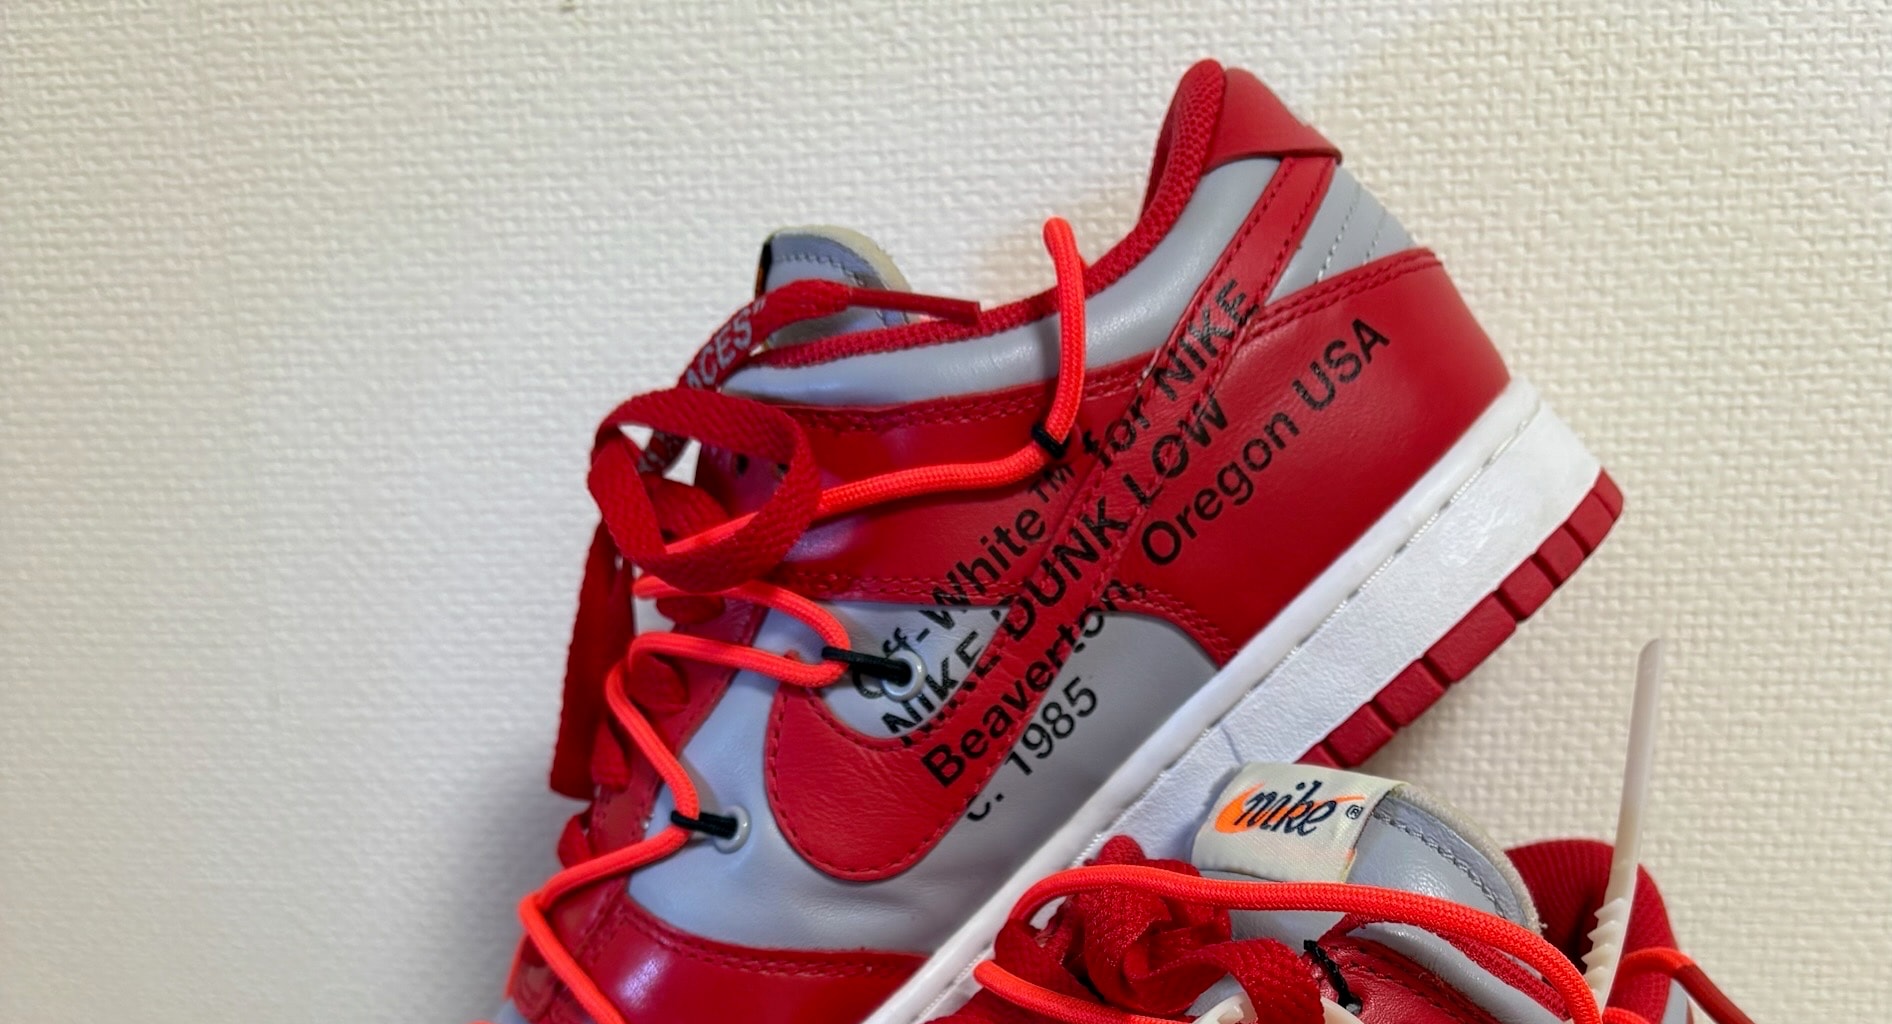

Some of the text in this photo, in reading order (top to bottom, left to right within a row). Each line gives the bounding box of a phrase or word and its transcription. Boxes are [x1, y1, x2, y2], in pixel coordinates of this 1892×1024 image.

[1082, 395, 1151, 469] for
[1153, 279, 1260, 401] NIKE
[881, 387, 1229, 746] NIKE DUNK LOW
[921, 318, 1391, 787] Beaverton, Oregon USA
[1004, 675, 1098, 777] 1985
